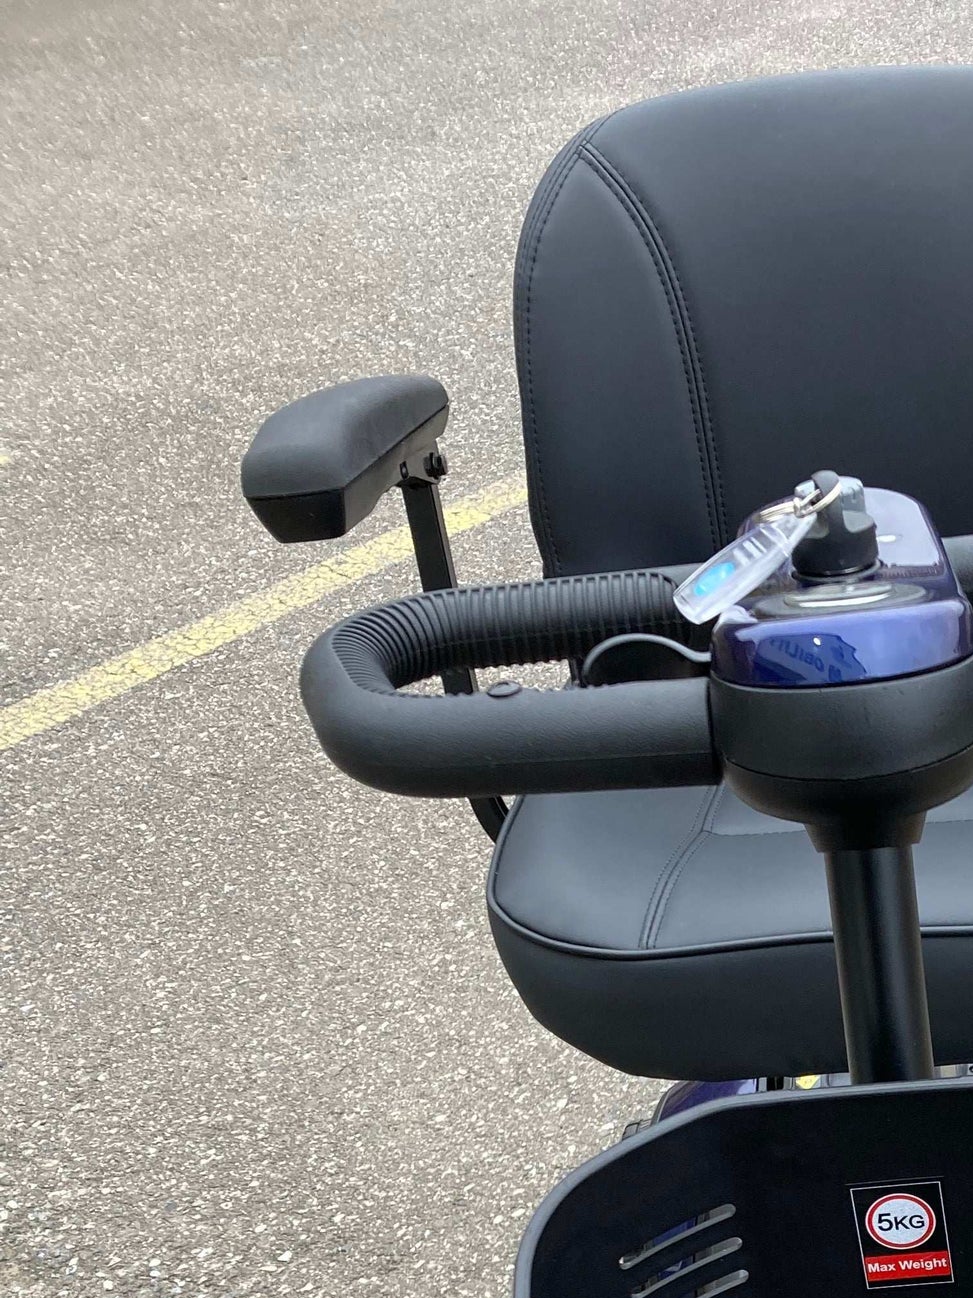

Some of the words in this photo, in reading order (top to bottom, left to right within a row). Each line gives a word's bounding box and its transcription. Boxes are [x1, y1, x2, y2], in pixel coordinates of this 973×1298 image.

[877, 1213, 925, 1231] 5KG
[867, 1263, 896, 1273] Max
[898, 1258, 947, 1270] Weight
